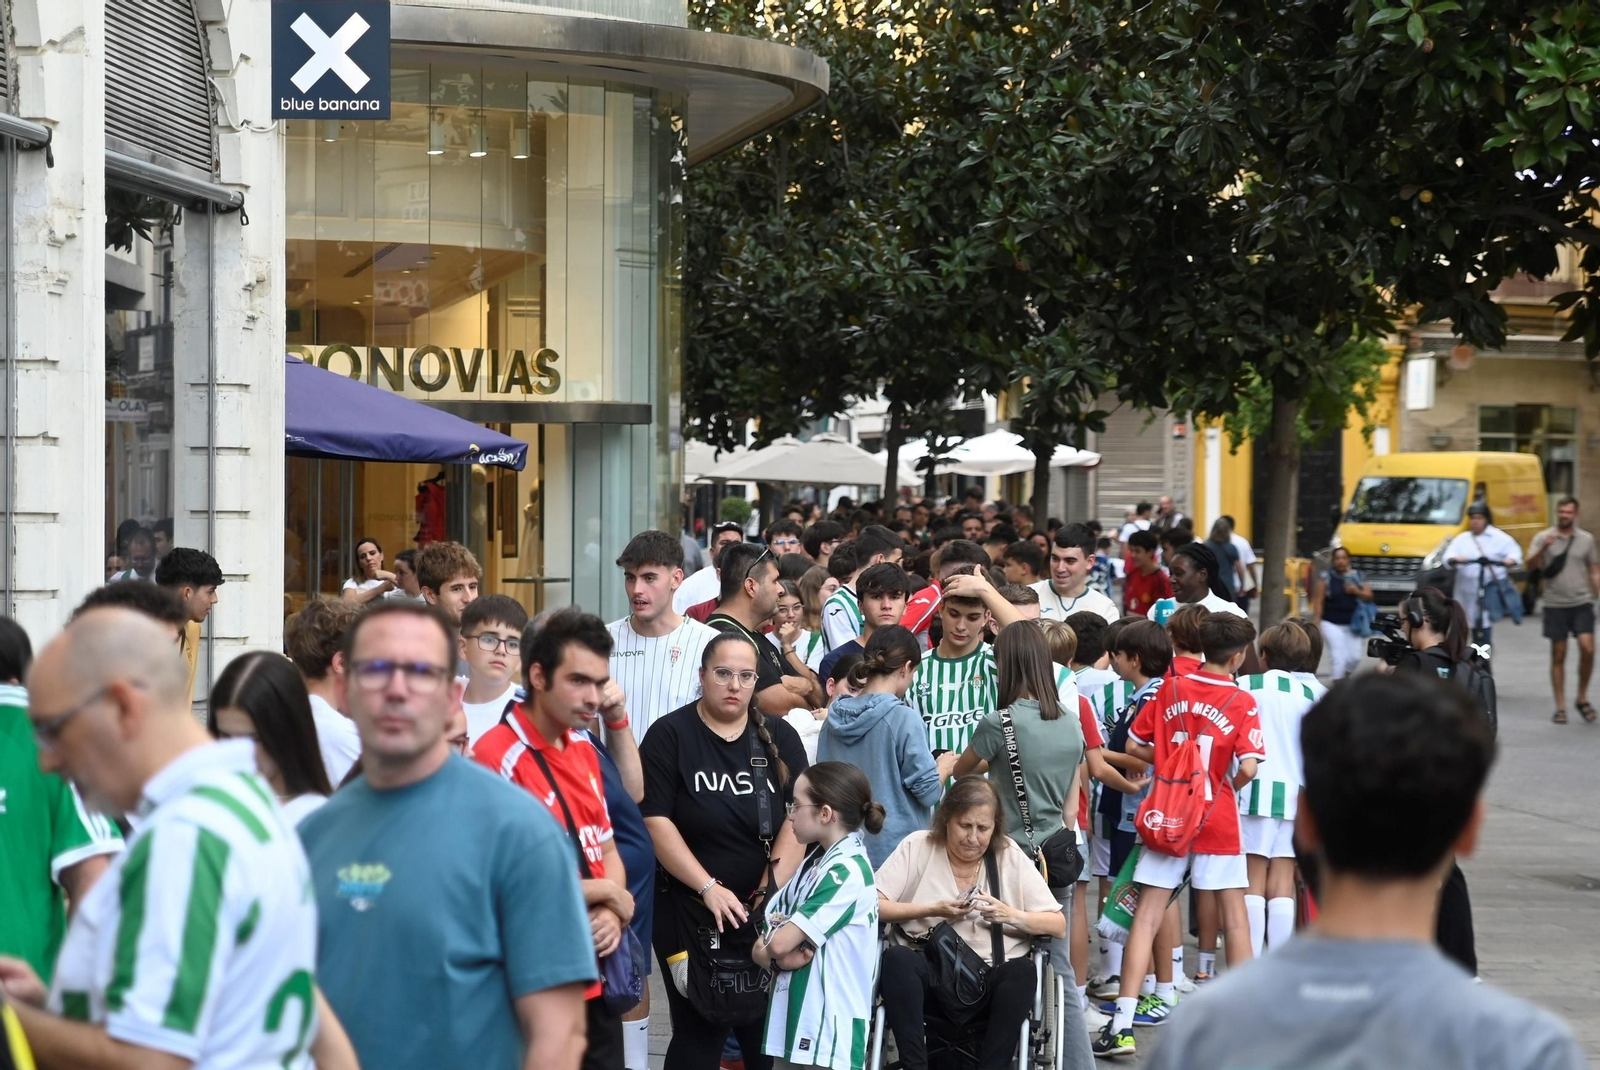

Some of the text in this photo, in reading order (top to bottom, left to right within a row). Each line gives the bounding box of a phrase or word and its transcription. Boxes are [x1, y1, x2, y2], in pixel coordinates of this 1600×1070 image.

[280, 97, 380, 110] blue banana
[609, 650, 644, 658] GIVOVA
[933, 709, 985, 728] GREE
[1191, 701, 1235, 736] MEDINA
[1012, 769, 1026, 798] LOLA
[759, 788, 768, 809] FILA
[717, 970, 775, 994] FILA
